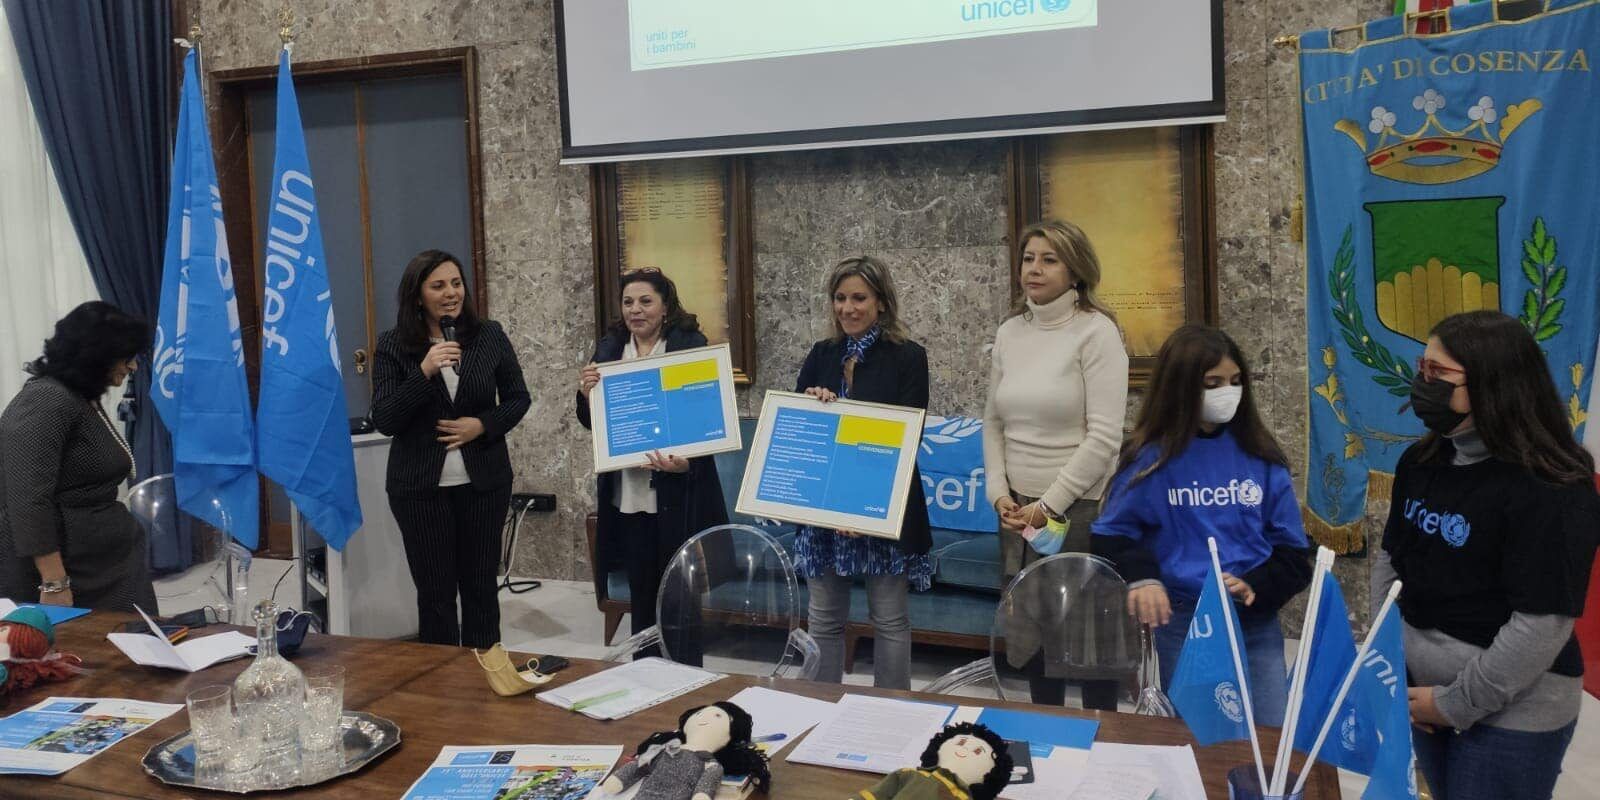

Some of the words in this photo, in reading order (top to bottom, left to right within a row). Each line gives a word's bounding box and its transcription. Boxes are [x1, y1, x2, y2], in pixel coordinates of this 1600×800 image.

[671, 29, 688, 41] per
[1392, 55, 1425, 80] DI
[1429, 48, 1591, 76] COSENZA
[262, 170, 316, 356] unicef
[1168, 479, 1239, 506] unicef
